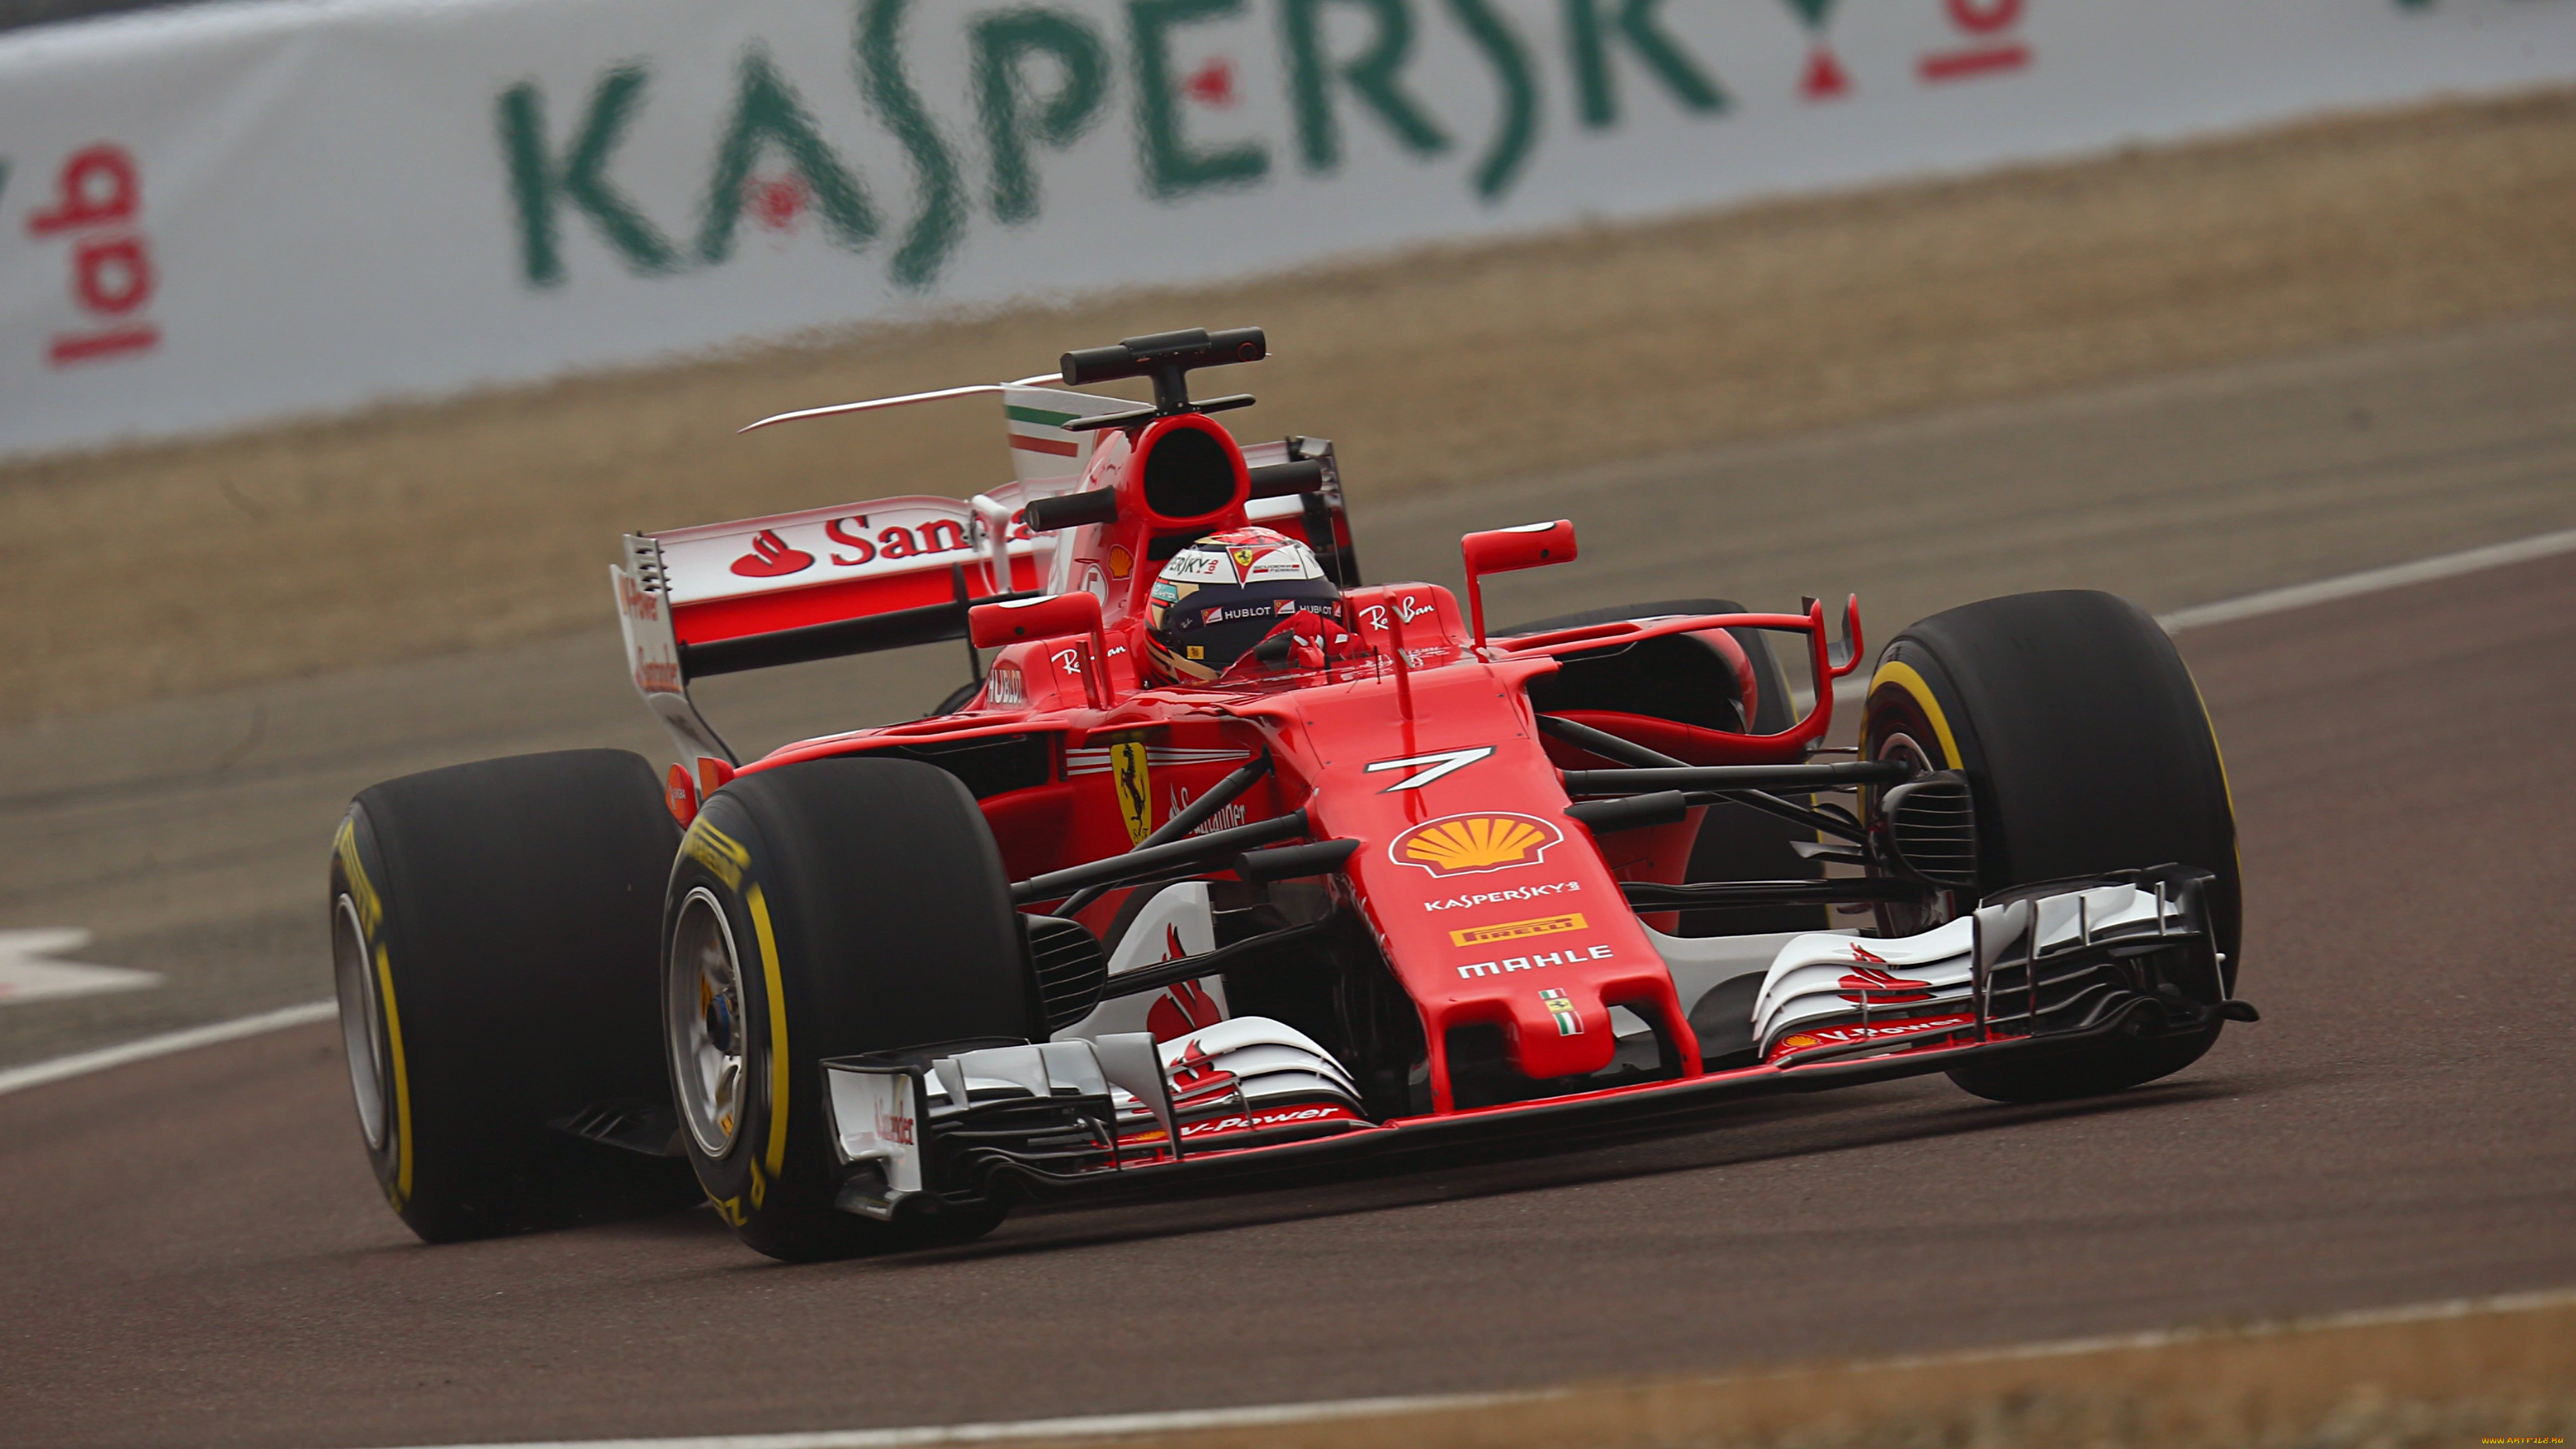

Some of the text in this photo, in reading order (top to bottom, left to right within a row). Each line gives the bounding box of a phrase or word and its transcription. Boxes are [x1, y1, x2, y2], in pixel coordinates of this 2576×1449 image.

[26, 142, 158, 365] lab
[1224, 606, 1271, 619] HUBLOT
[1363, 745, 1497, 794] 7
[1424, 882, 1564, 911] KASPERSKY
[1462, 917, 1574, 943] PIRELLI
[1456, 945, 1614, 979] MAHLE
